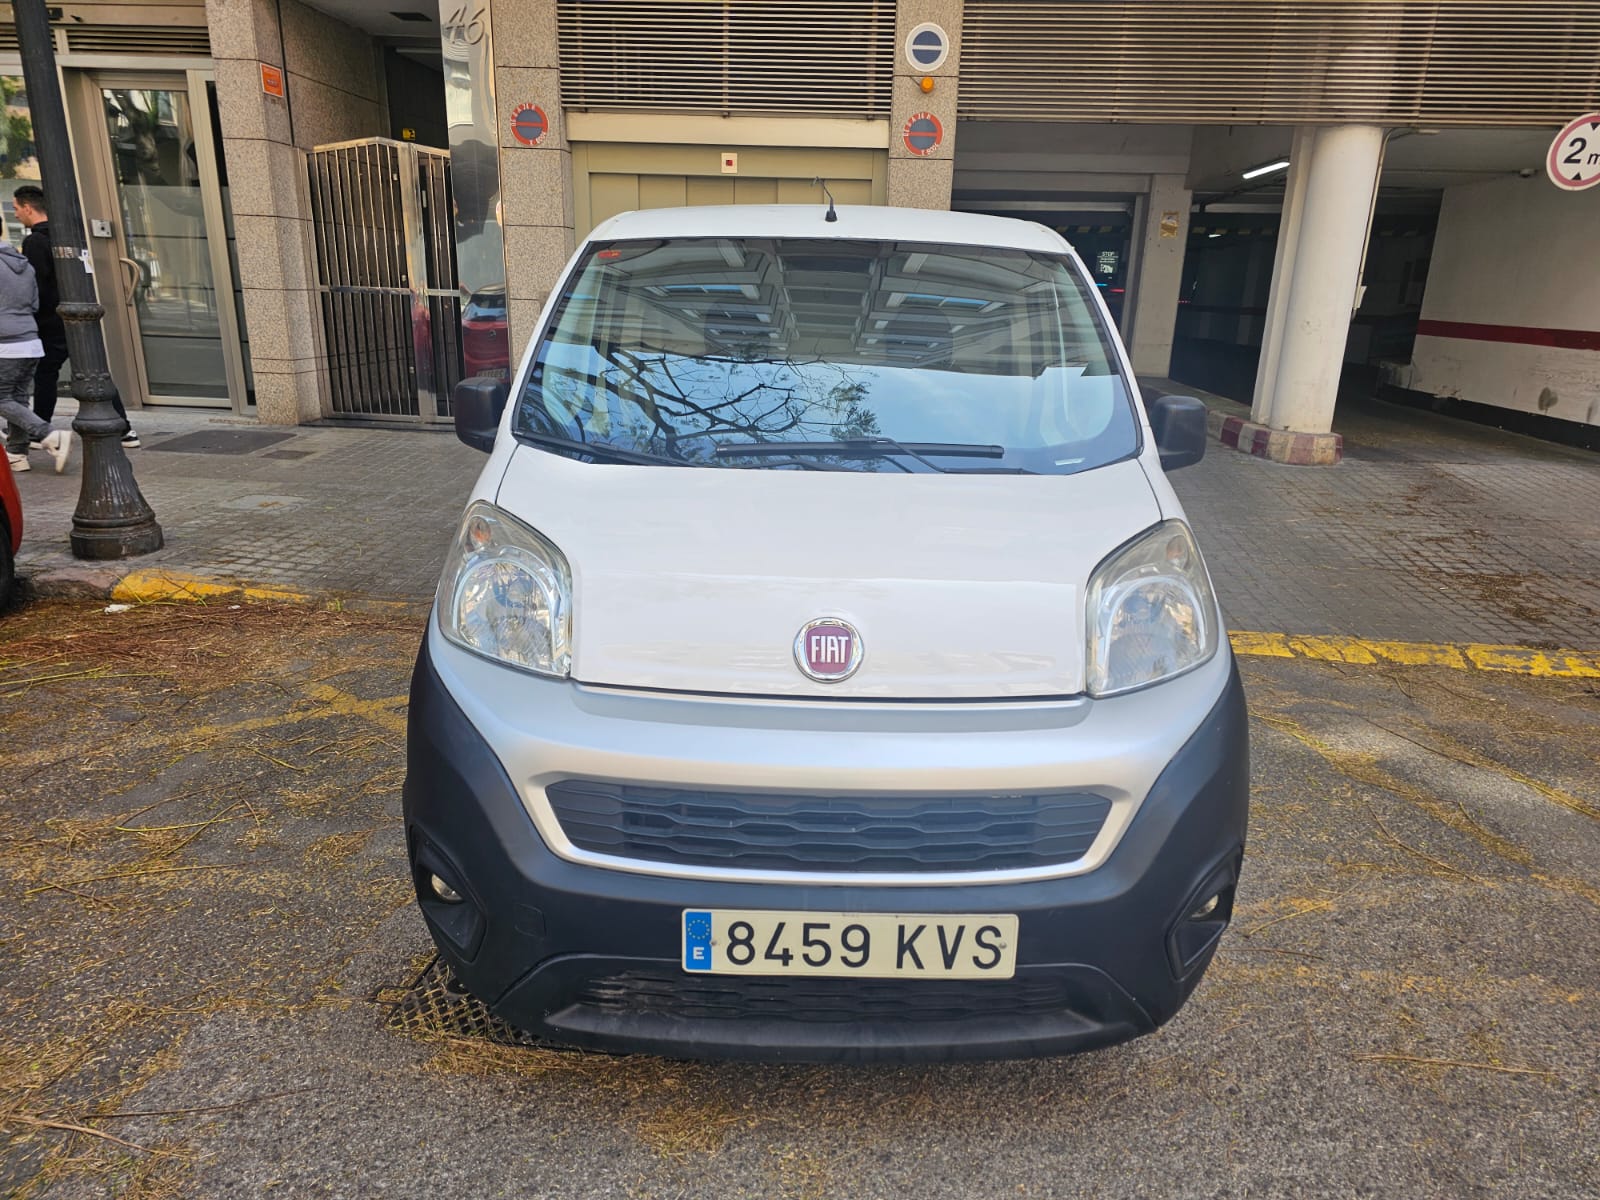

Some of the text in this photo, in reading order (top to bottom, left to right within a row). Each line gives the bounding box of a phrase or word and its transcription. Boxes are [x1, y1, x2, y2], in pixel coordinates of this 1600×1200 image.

[1563, 137, 1587, 164] 2
[811, 635, 849, 664] FIAT
[693, 921, 1002, 970] E 8459 KVS
